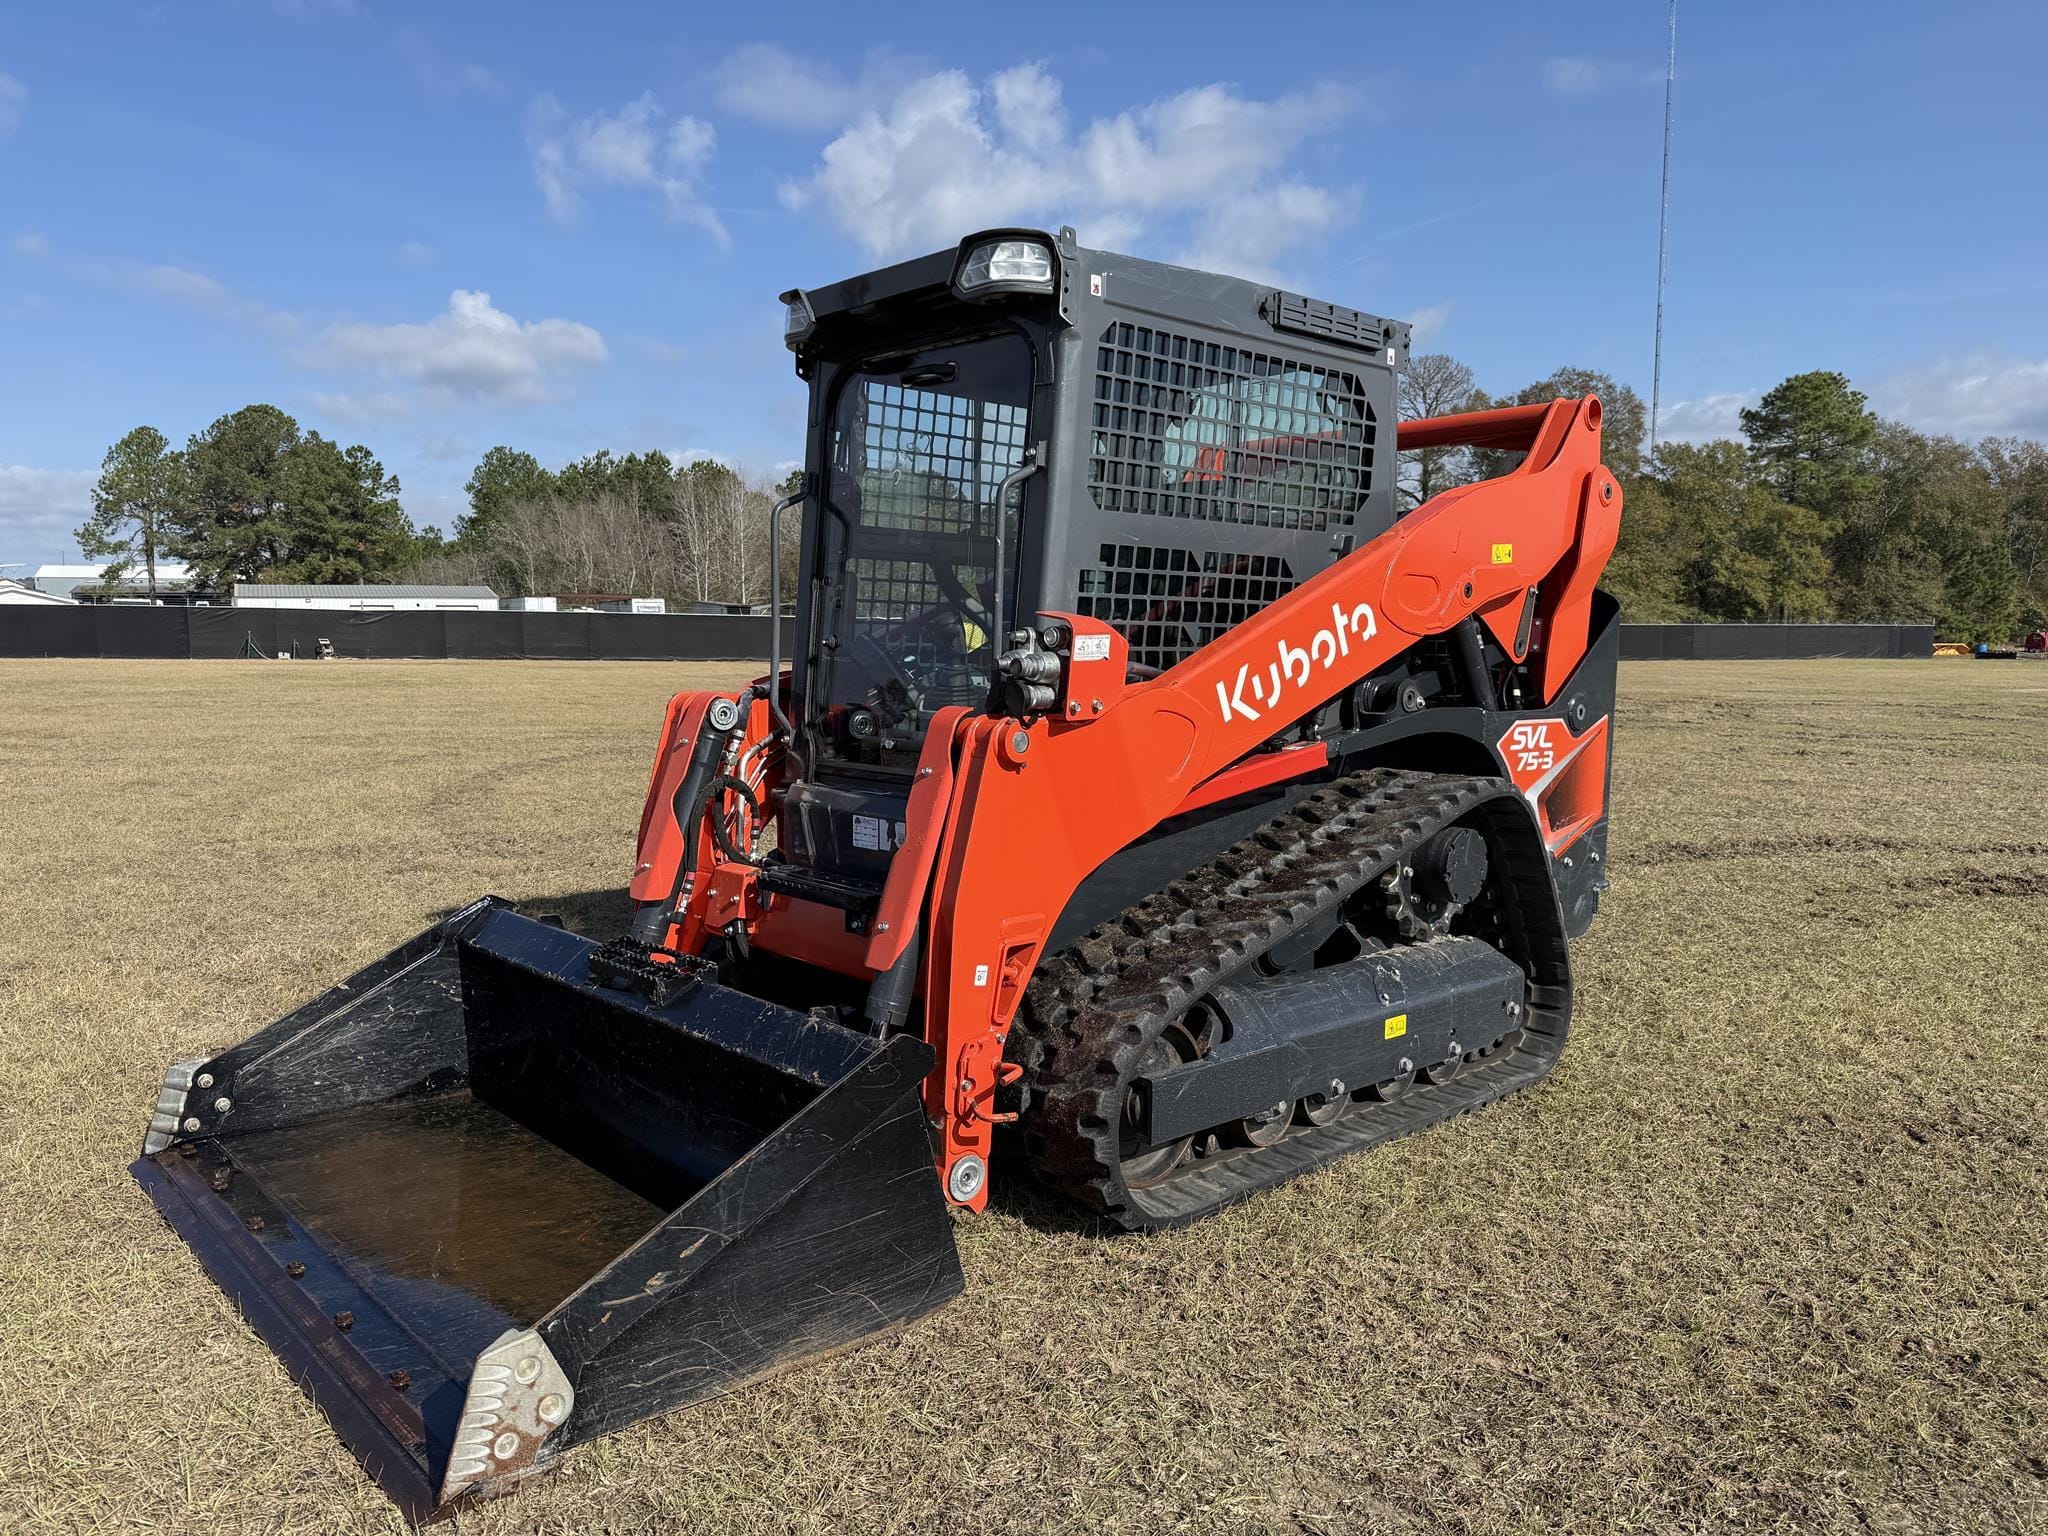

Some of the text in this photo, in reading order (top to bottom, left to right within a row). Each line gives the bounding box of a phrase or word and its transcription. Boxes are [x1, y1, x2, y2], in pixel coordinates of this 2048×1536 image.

[1216, 602, 1377, 723] Kubota
[1510, 725, 1553, 750] SVL
[1516, 750, 1554, 771] 75-3
